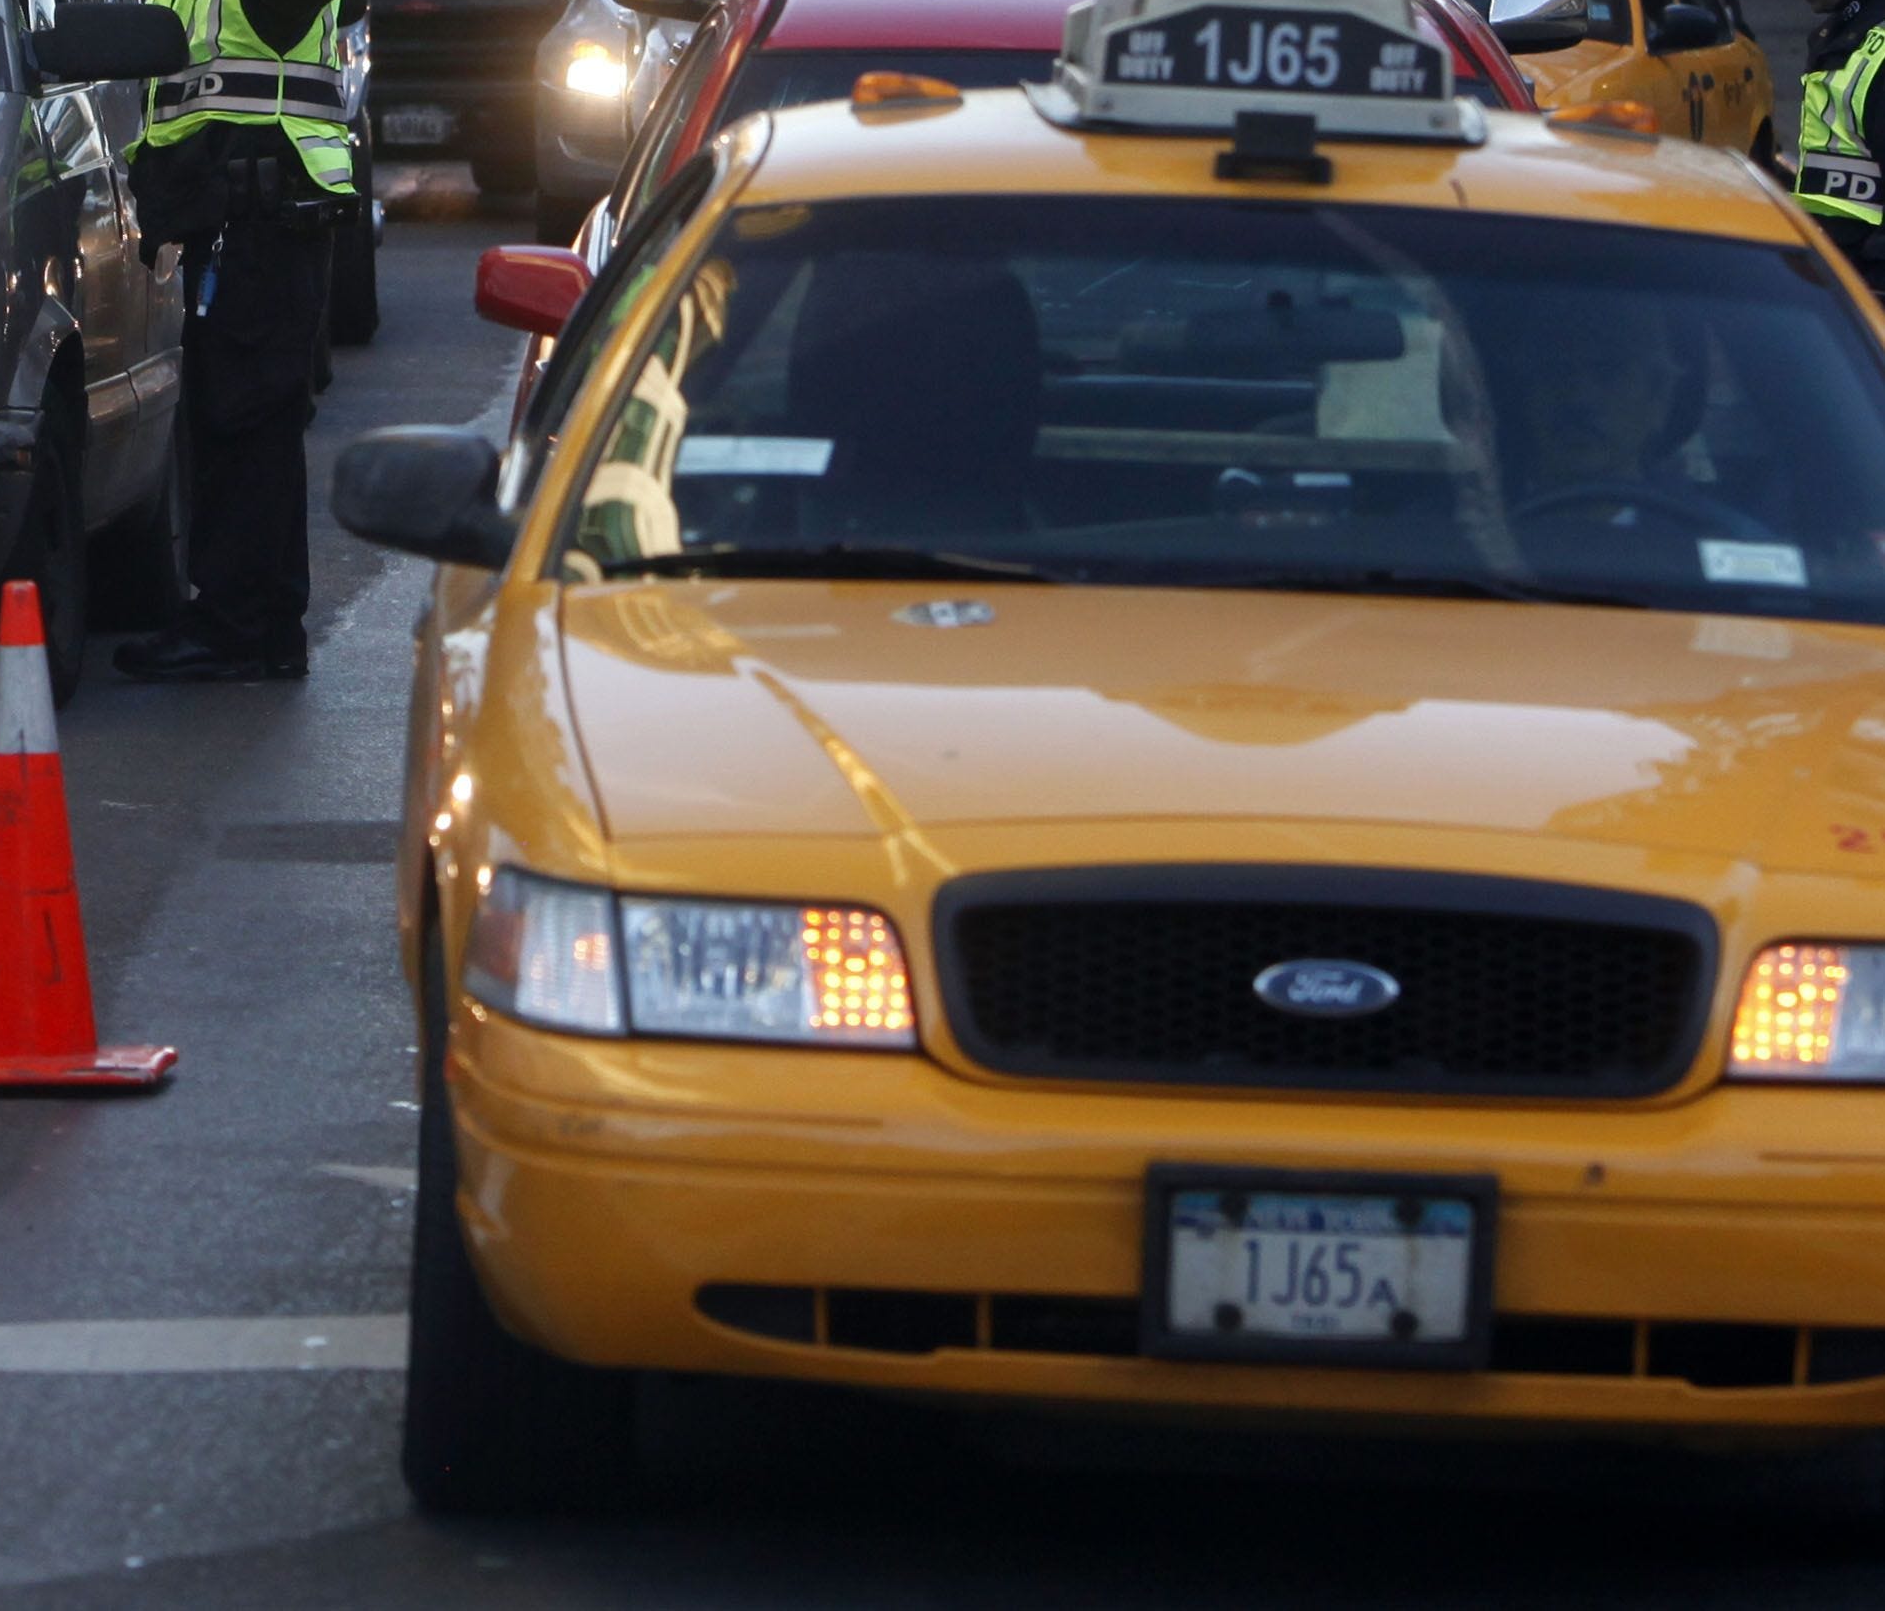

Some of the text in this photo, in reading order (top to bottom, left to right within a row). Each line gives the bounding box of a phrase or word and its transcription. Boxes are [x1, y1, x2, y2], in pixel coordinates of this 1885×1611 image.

[1195, 19, 1341, 87] 1J65
[1824, 171, 1876, 200] PD
[1287, 970, 1364, 1004] Ford
[1244, 1240, 1399, 1310] 1J65A
